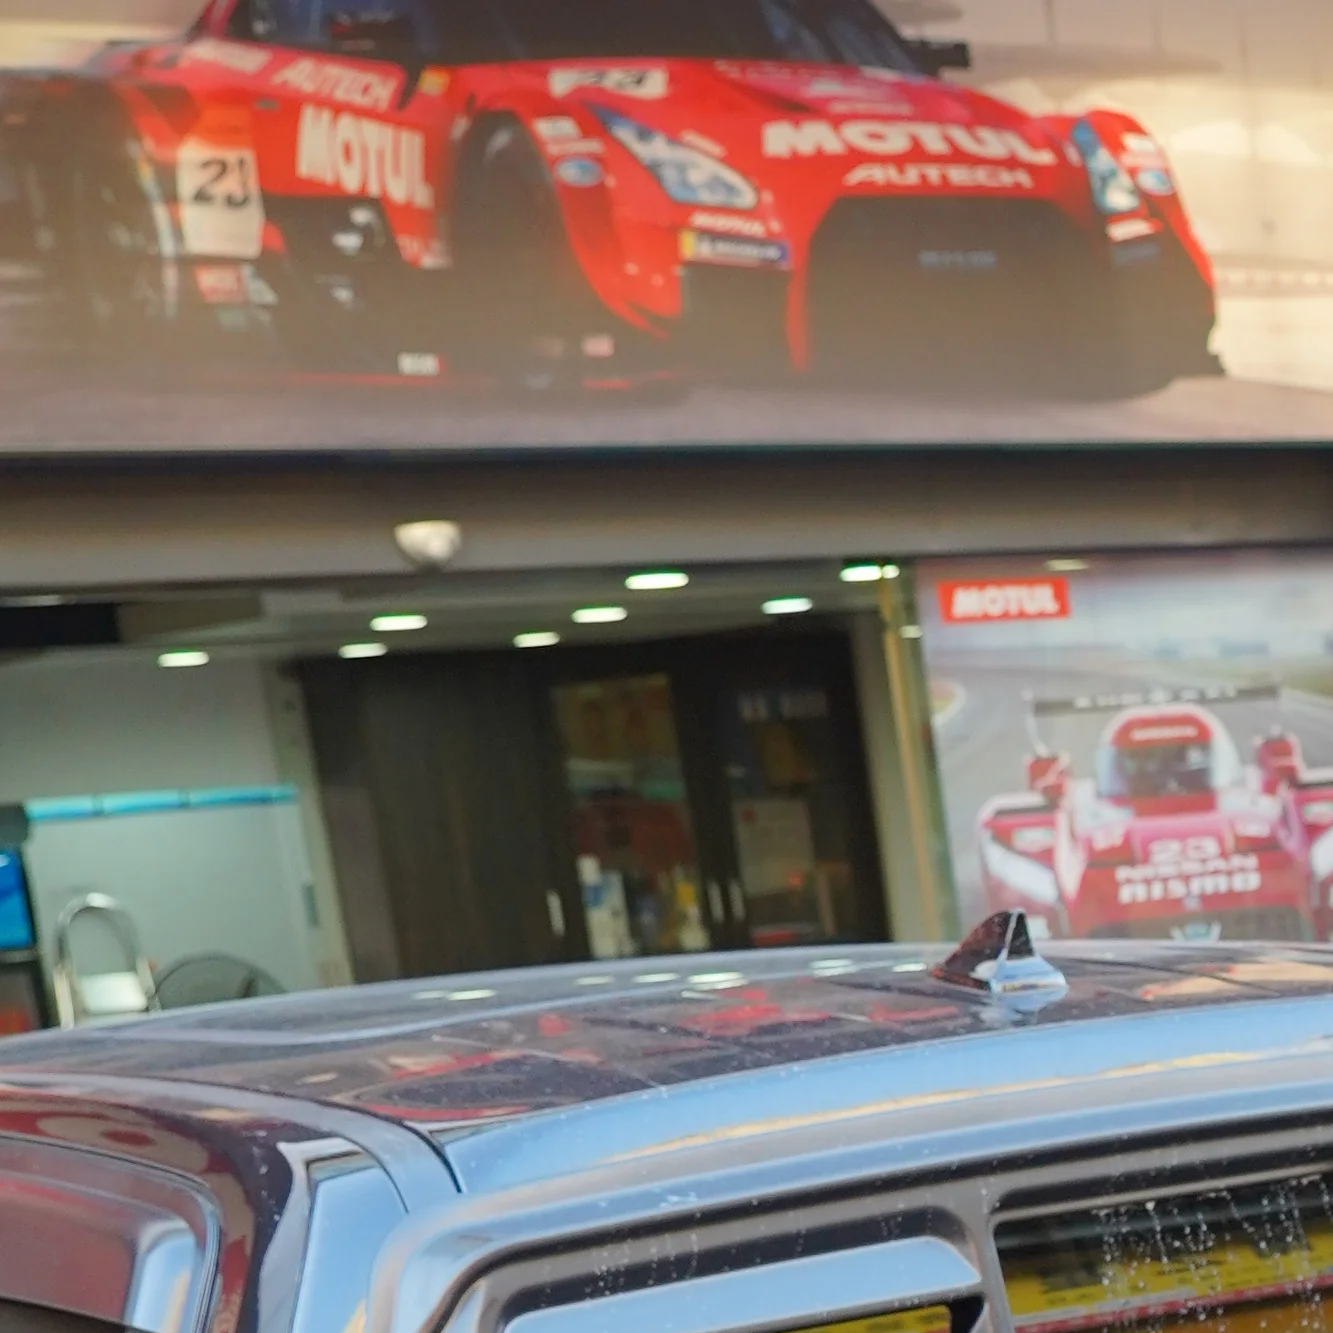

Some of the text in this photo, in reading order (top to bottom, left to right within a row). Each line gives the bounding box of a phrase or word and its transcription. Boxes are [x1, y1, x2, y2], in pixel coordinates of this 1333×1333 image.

[296, 101, 435, 210] MOTUL
[761, 118, 1058, 166] MOTUL
[842, 162, 1034, 189] AUTECH
[951, 583, 1060, 619] MOTUL
